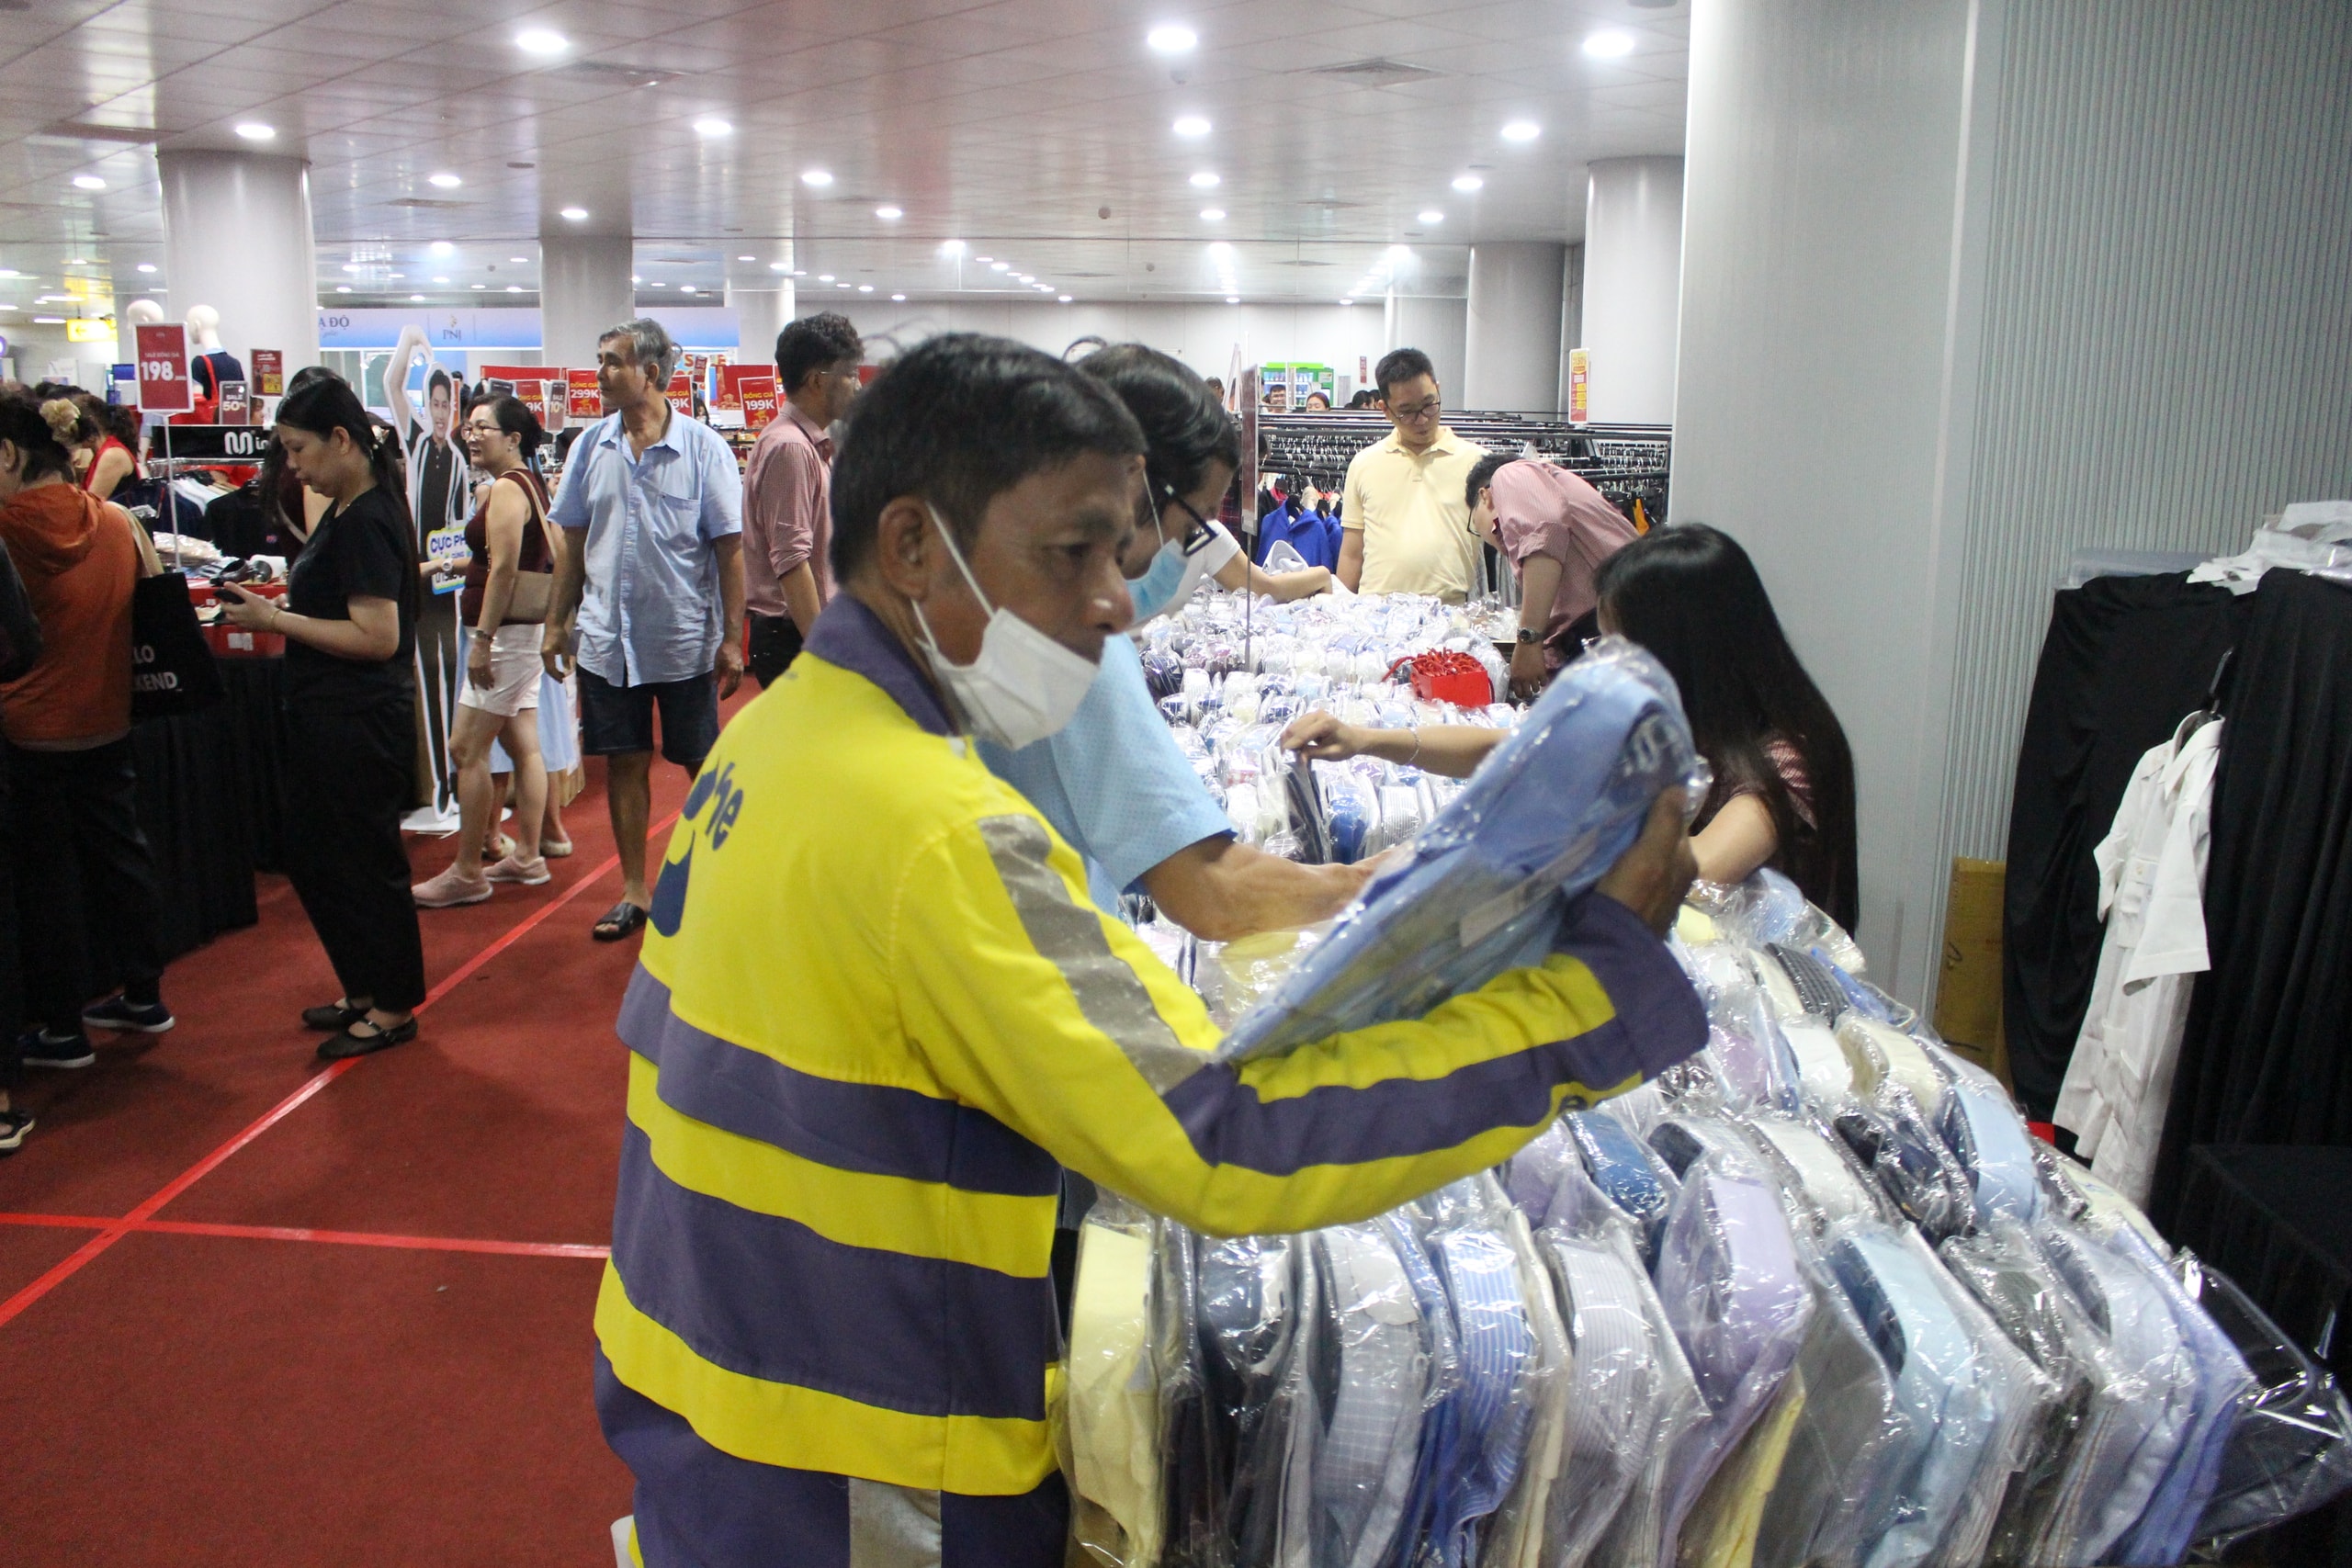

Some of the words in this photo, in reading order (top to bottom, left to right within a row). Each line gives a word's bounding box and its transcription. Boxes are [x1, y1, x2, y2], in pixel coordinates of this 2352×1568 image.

[141, 360, 174, 381] 198
[571, 389, 599, 399] 299K
[526, 401, 543, 412] 9K
[745, 399, 775, 411] 199K
